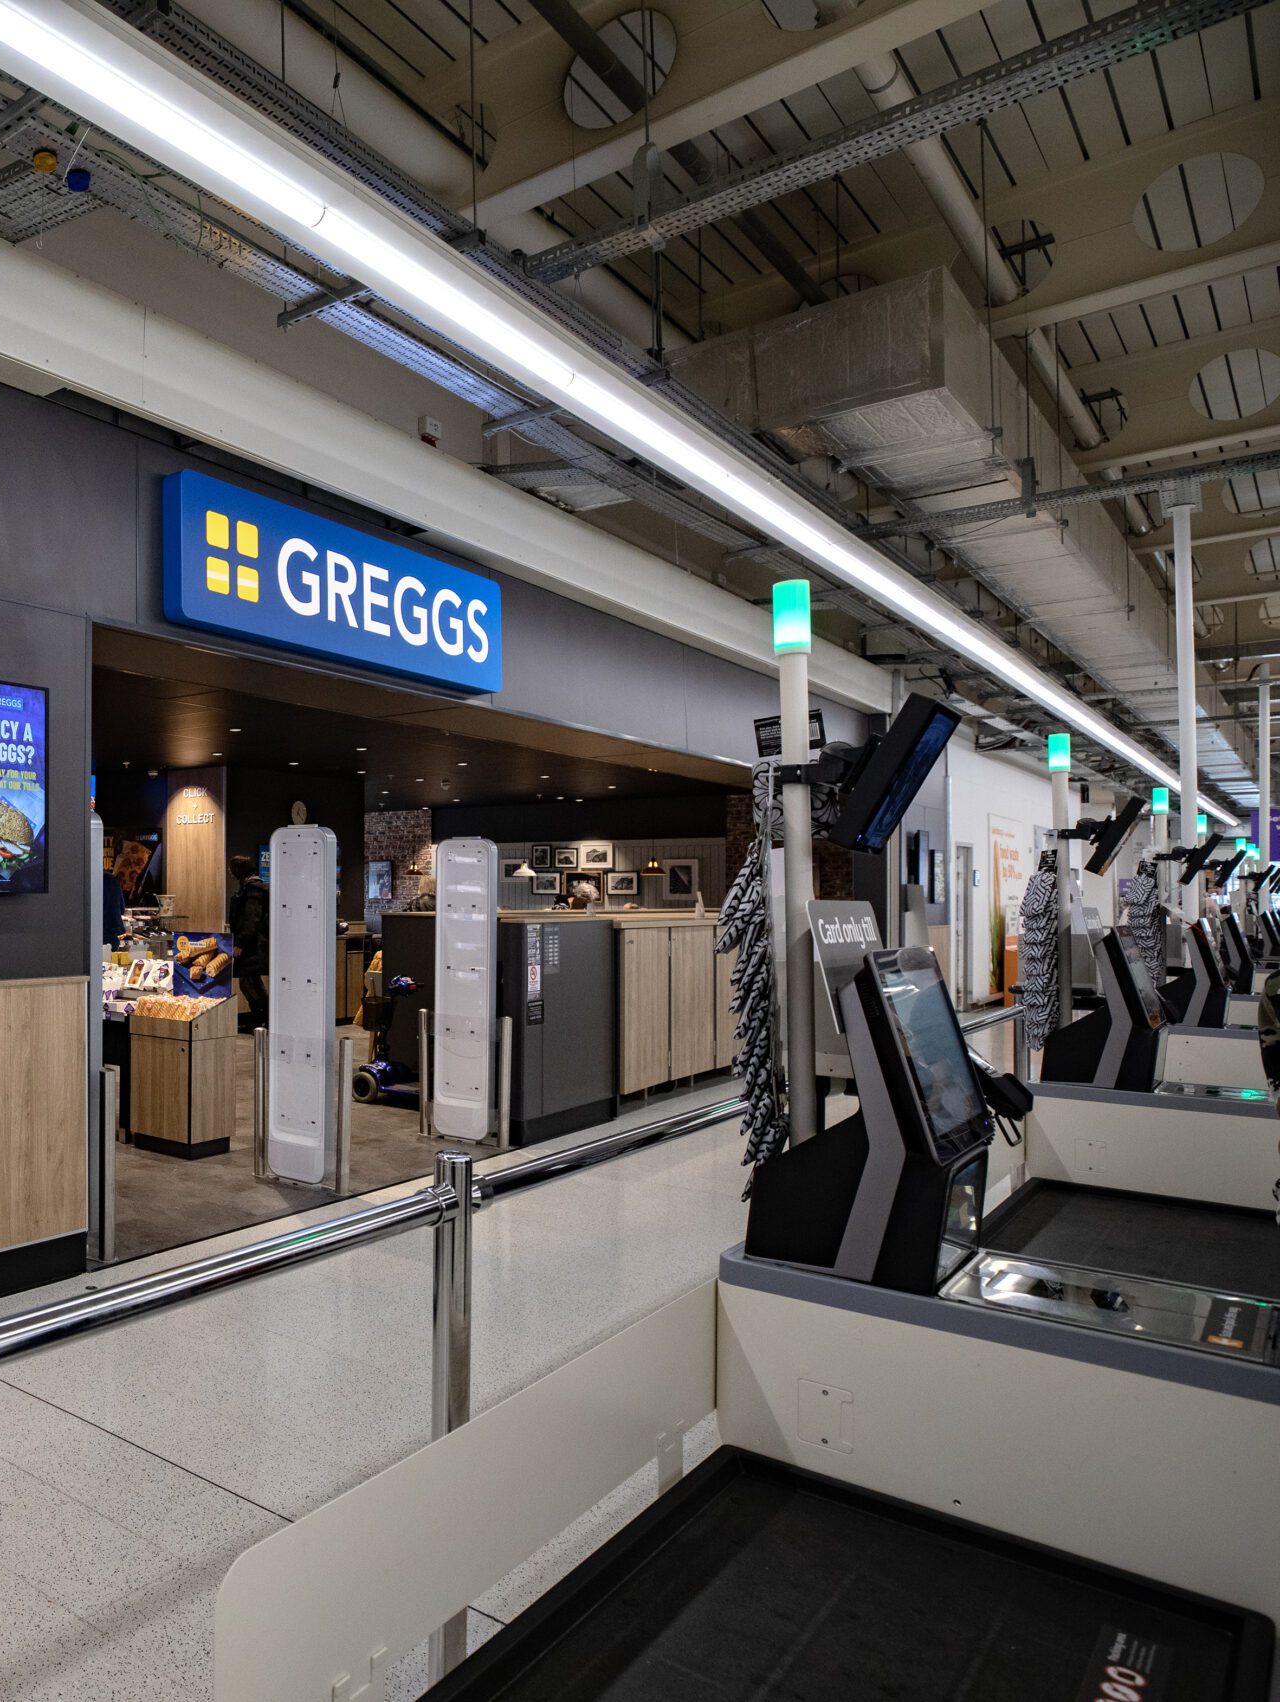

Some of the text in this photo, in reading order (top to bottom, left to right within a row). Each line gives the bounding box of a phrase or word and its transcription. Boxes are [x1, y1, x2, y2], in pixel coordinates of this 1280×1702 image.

[277, 537, 489, 664] GREGGS
[23, 723, 33, 742] A
[7, 769, 18, 779] FOR
[21, 771, 36, 780] YOUR
[0, 780, 7, 789] AT
[183, 787, 208, 798] CLICK
[176, 813, 215, 825] COLLECT
[818, 916, 877, 949] Card only till
